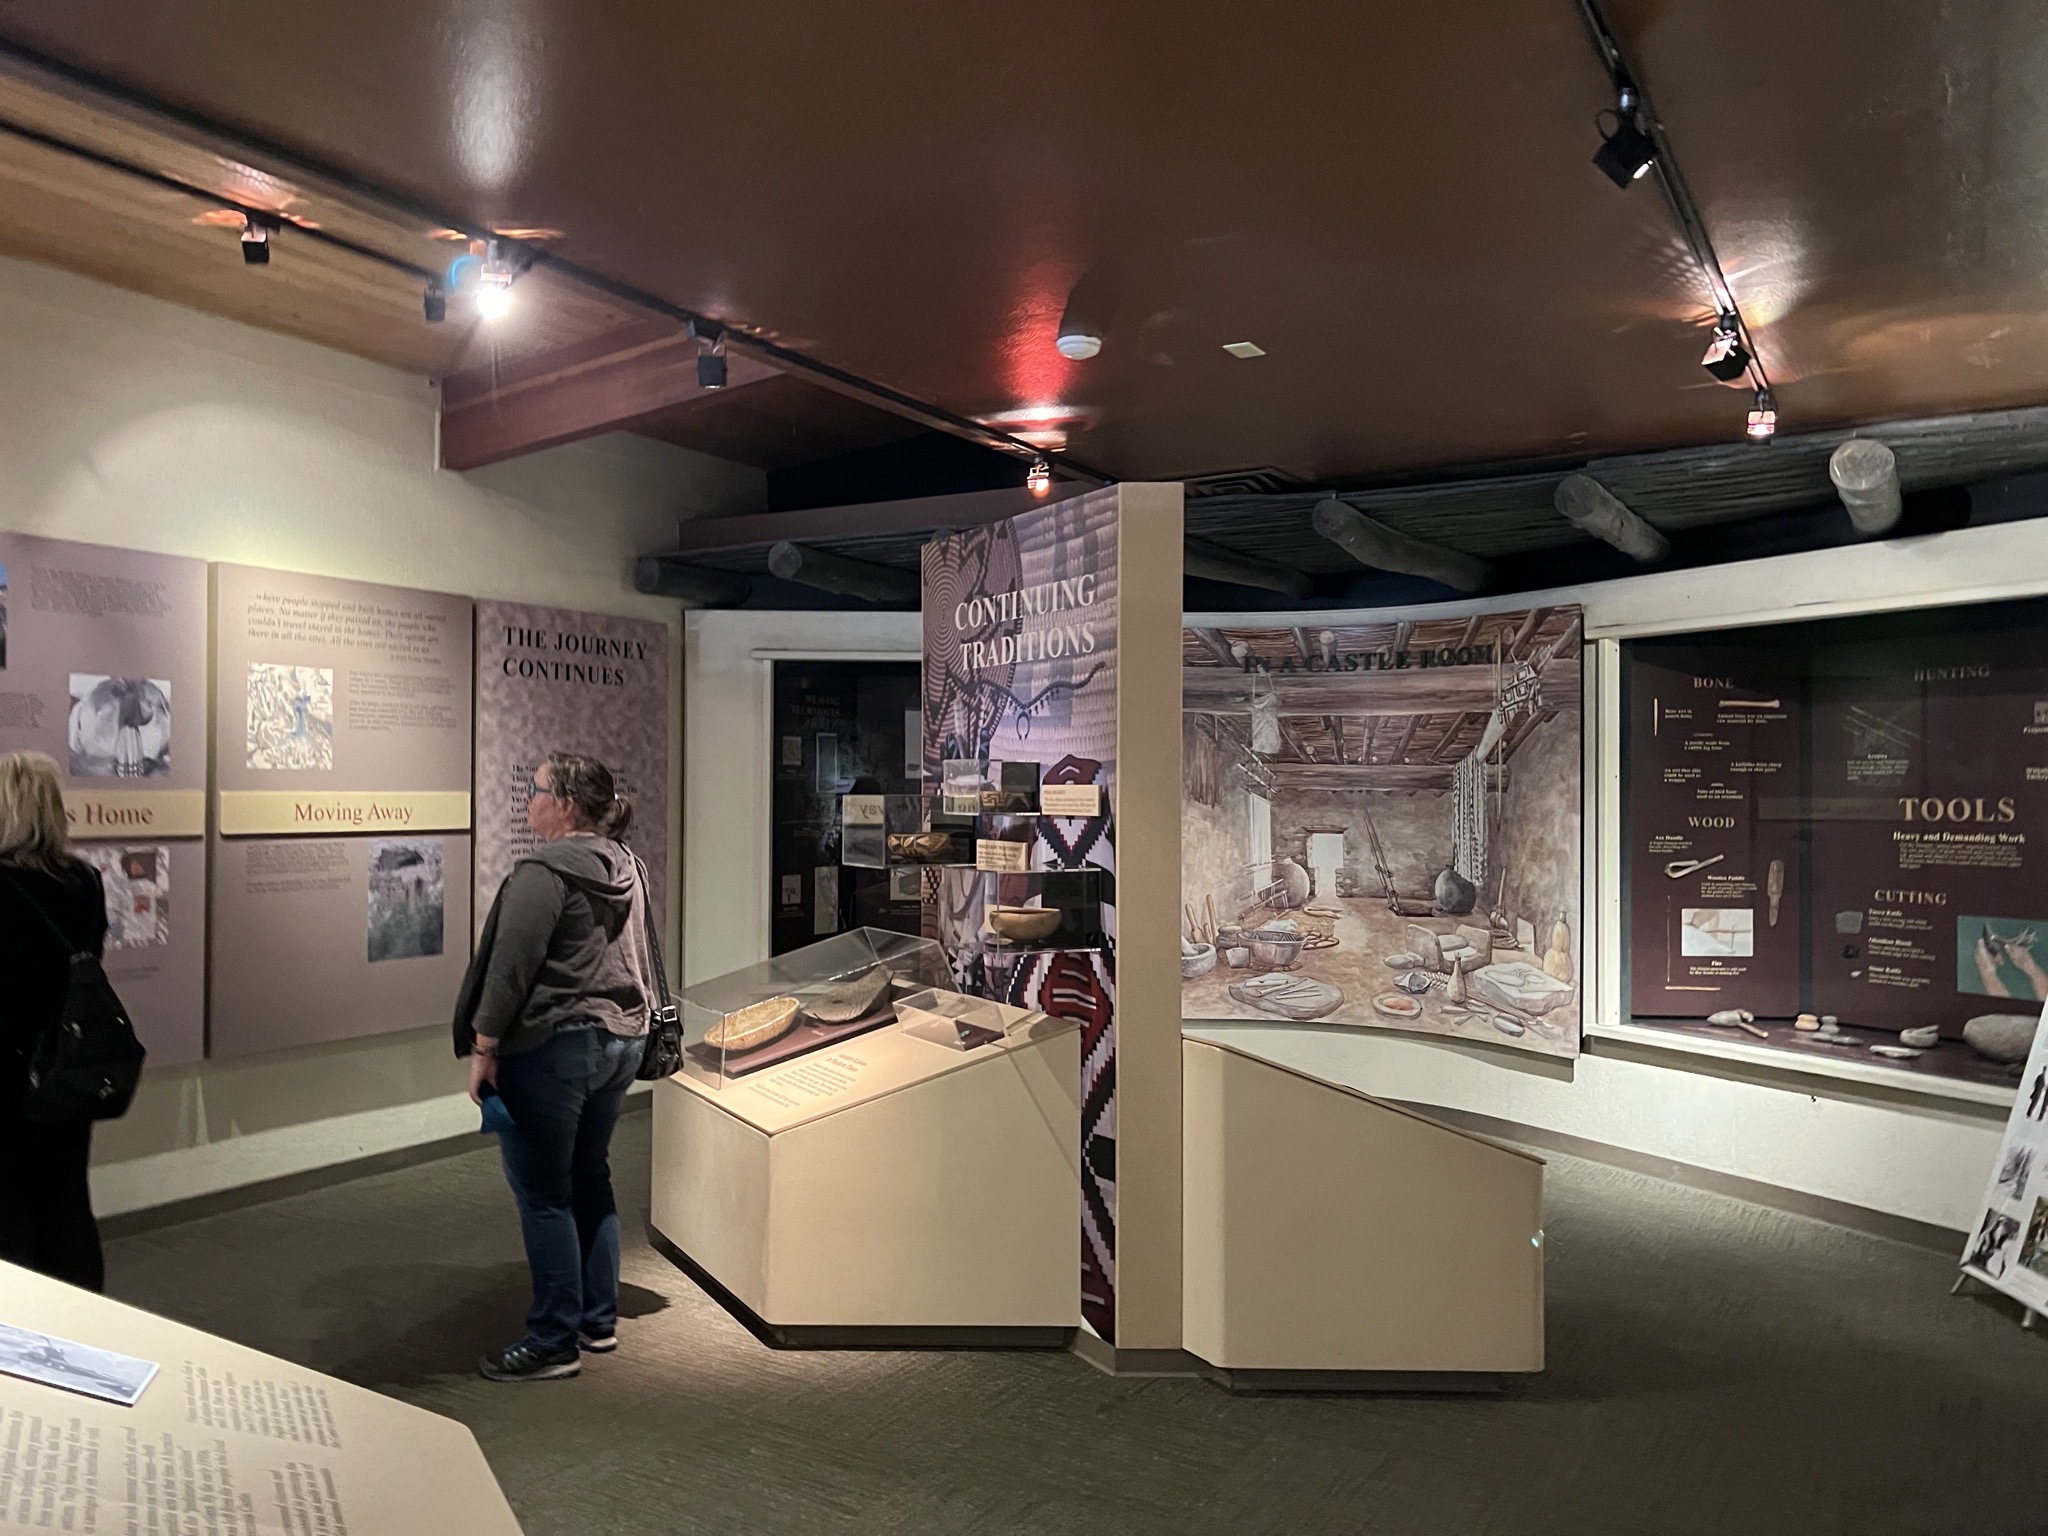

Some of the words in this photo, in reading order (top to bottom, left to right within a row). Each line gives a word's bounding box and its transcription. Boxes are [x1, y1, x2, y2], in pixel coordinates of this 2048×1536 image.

[955, 574, 1096, 631] CONTINUING
[502, 626, 547, 650] THE
[554, 632, 647, 660] JOURNEY
[959, 622, 1095, 671] TRADITIONS
[1243, 655, 1271, 674] IN
[1279, 656, 1297, 674] A
[1305, 651, 1411, 673] CASTLE
[1419, 645, 1494, 669] ROOM
[502, 657, 624, 687] CONTINUES
[1693, 677, 1735, 689] BONE
[1913, 664, 1991, 682] HUNTING
[86, 804, 153, 826] Home
[294, 803, 363, 824] Moving
[367, 802, 413, 824] Away
[1898, 796, 2016, 823] TOOLS
[1688, 816, 1735, 828] WOOD
[1893, 831, 1921, 842] Heavy
[1922, 831, 1941, 841] and
[1942, 831, 1997, 845] Demanding
[1998, 832, 2026, 844] Work
[1874, 888, 1948, 906] CUTTING
